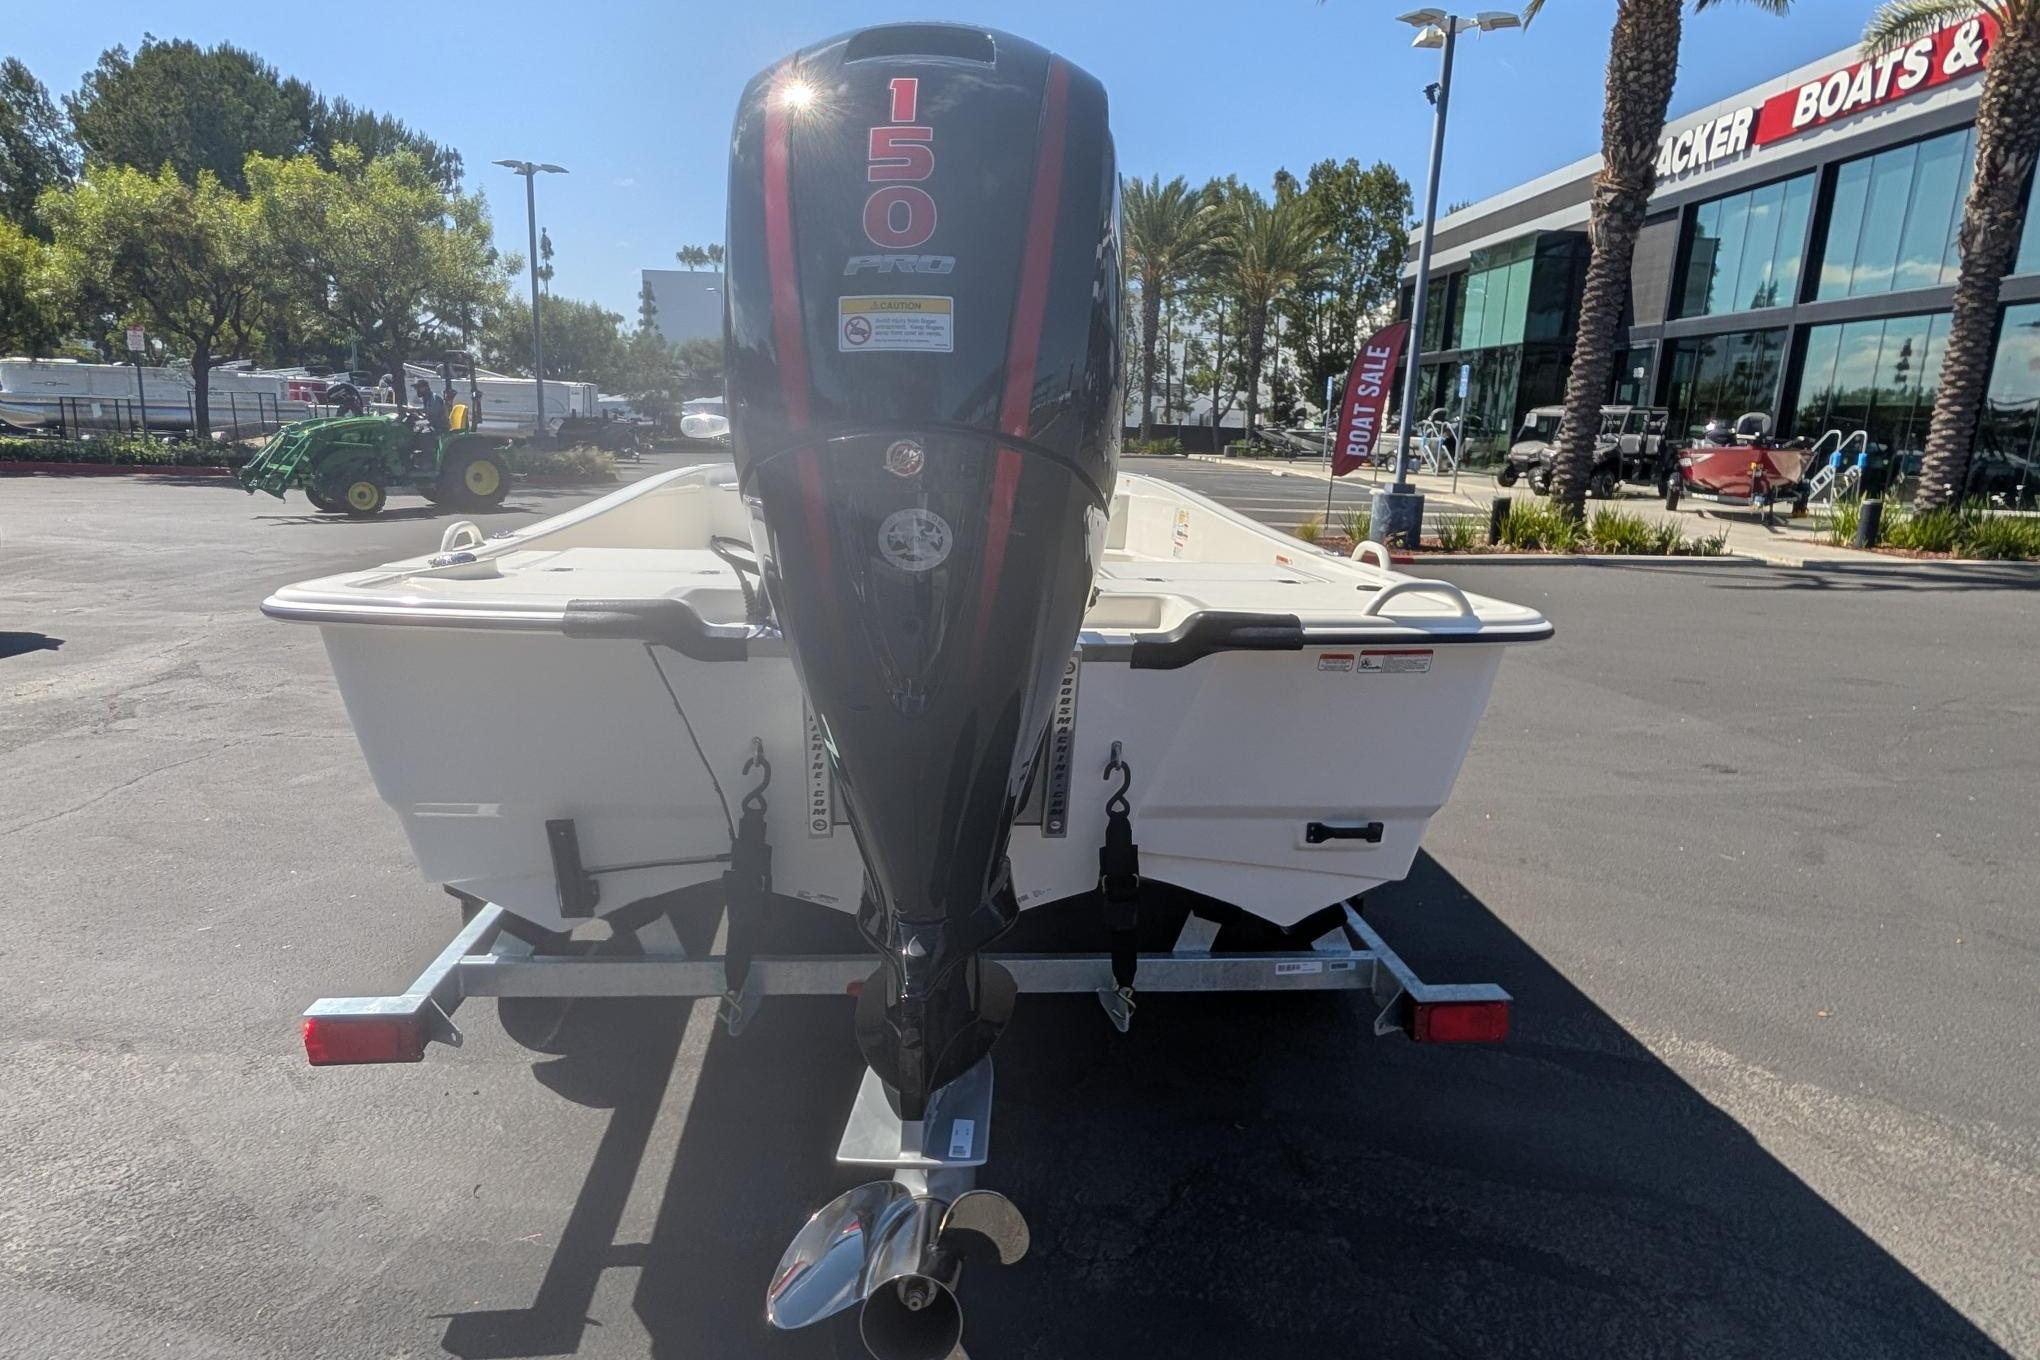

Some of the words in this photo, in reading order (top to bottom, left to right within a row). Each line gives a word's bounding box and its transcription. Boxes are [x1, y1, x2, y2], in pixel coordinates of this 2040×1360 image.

[1651, 106, 1754, 178] ACKER
[1791, 36, 1934, 128] BOATS
[1943, 19, 1983, 75] &
[880, 302, 921, 310] CAUTION
[1357, 345, 1390, 397] SALE
[1346, 403, 1376, 457] BOAT
